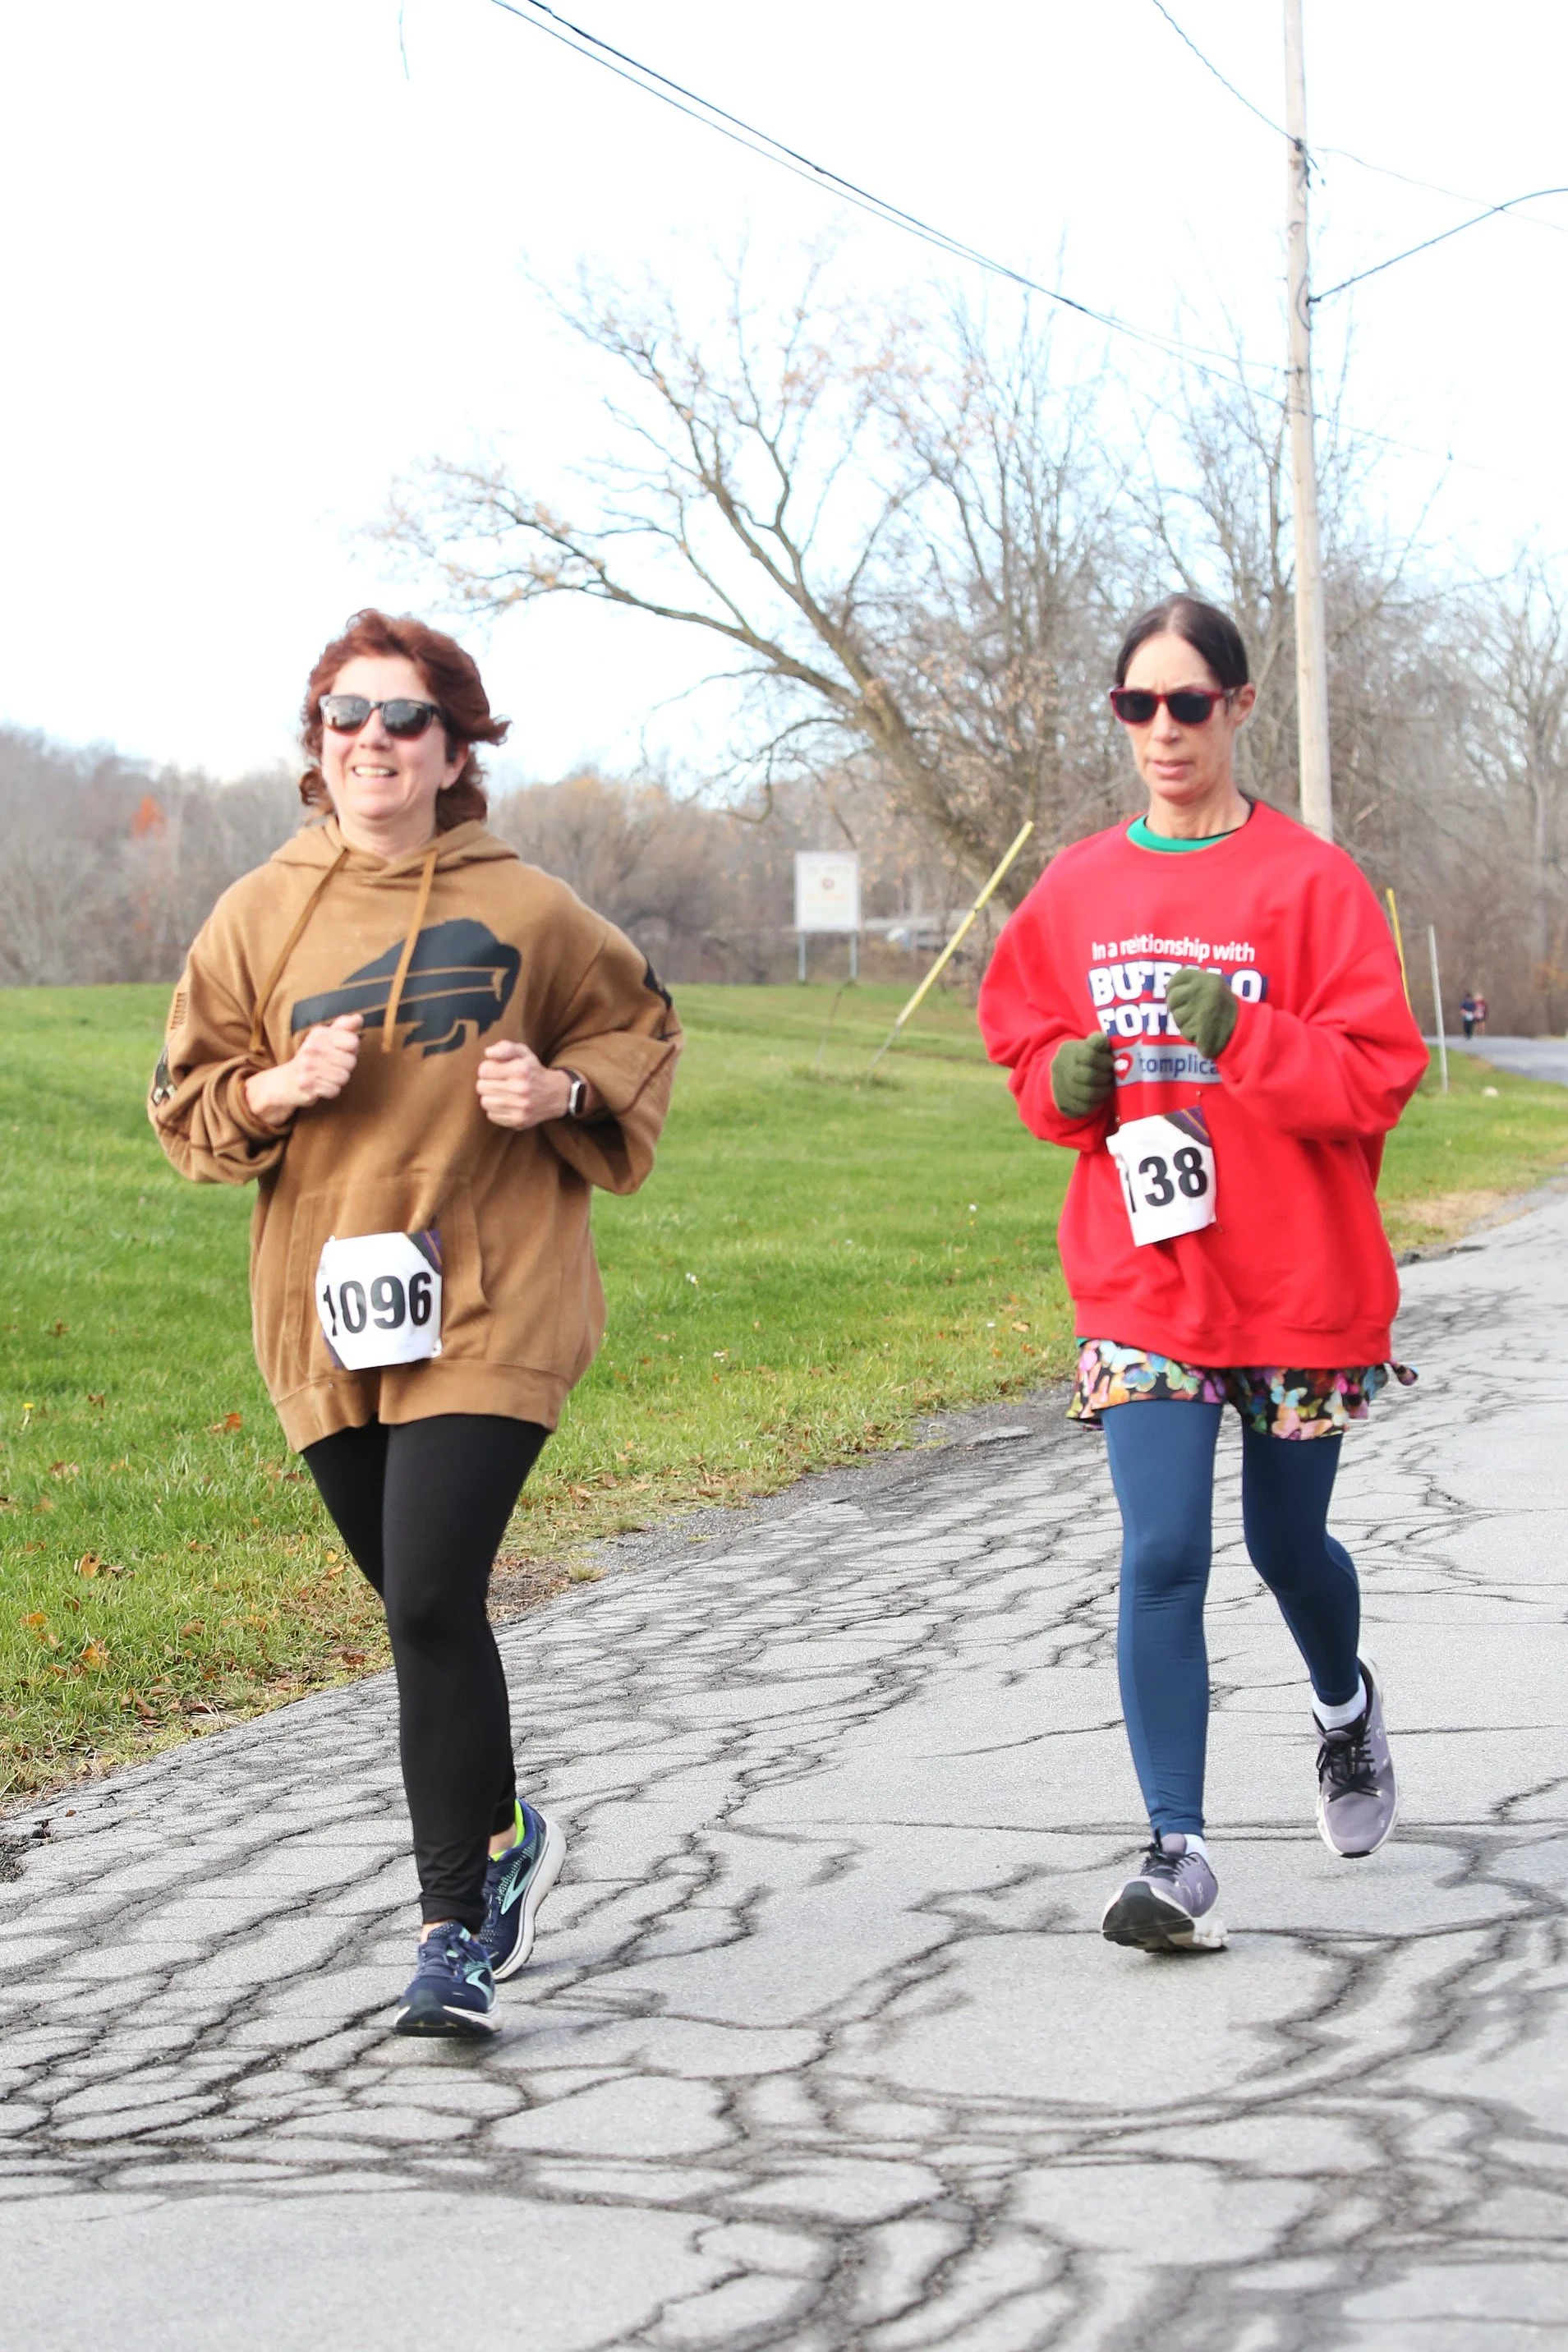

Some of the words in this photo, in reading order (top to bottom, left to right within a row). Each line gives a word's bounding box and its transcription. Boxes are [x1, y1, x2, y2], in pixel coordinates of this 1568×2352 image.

[1092, 941, 1106, 961] In
[1107, 941, 1118, 958] a
[1120, 933, 1210, 963] retionship
[1212, 941, 1256, 962] with
[1088, 960, 1263, 1006] BUFFO
[1139, 1052, 1219, 1078] omplica
[323, 1272, 432, 1337] 1096
